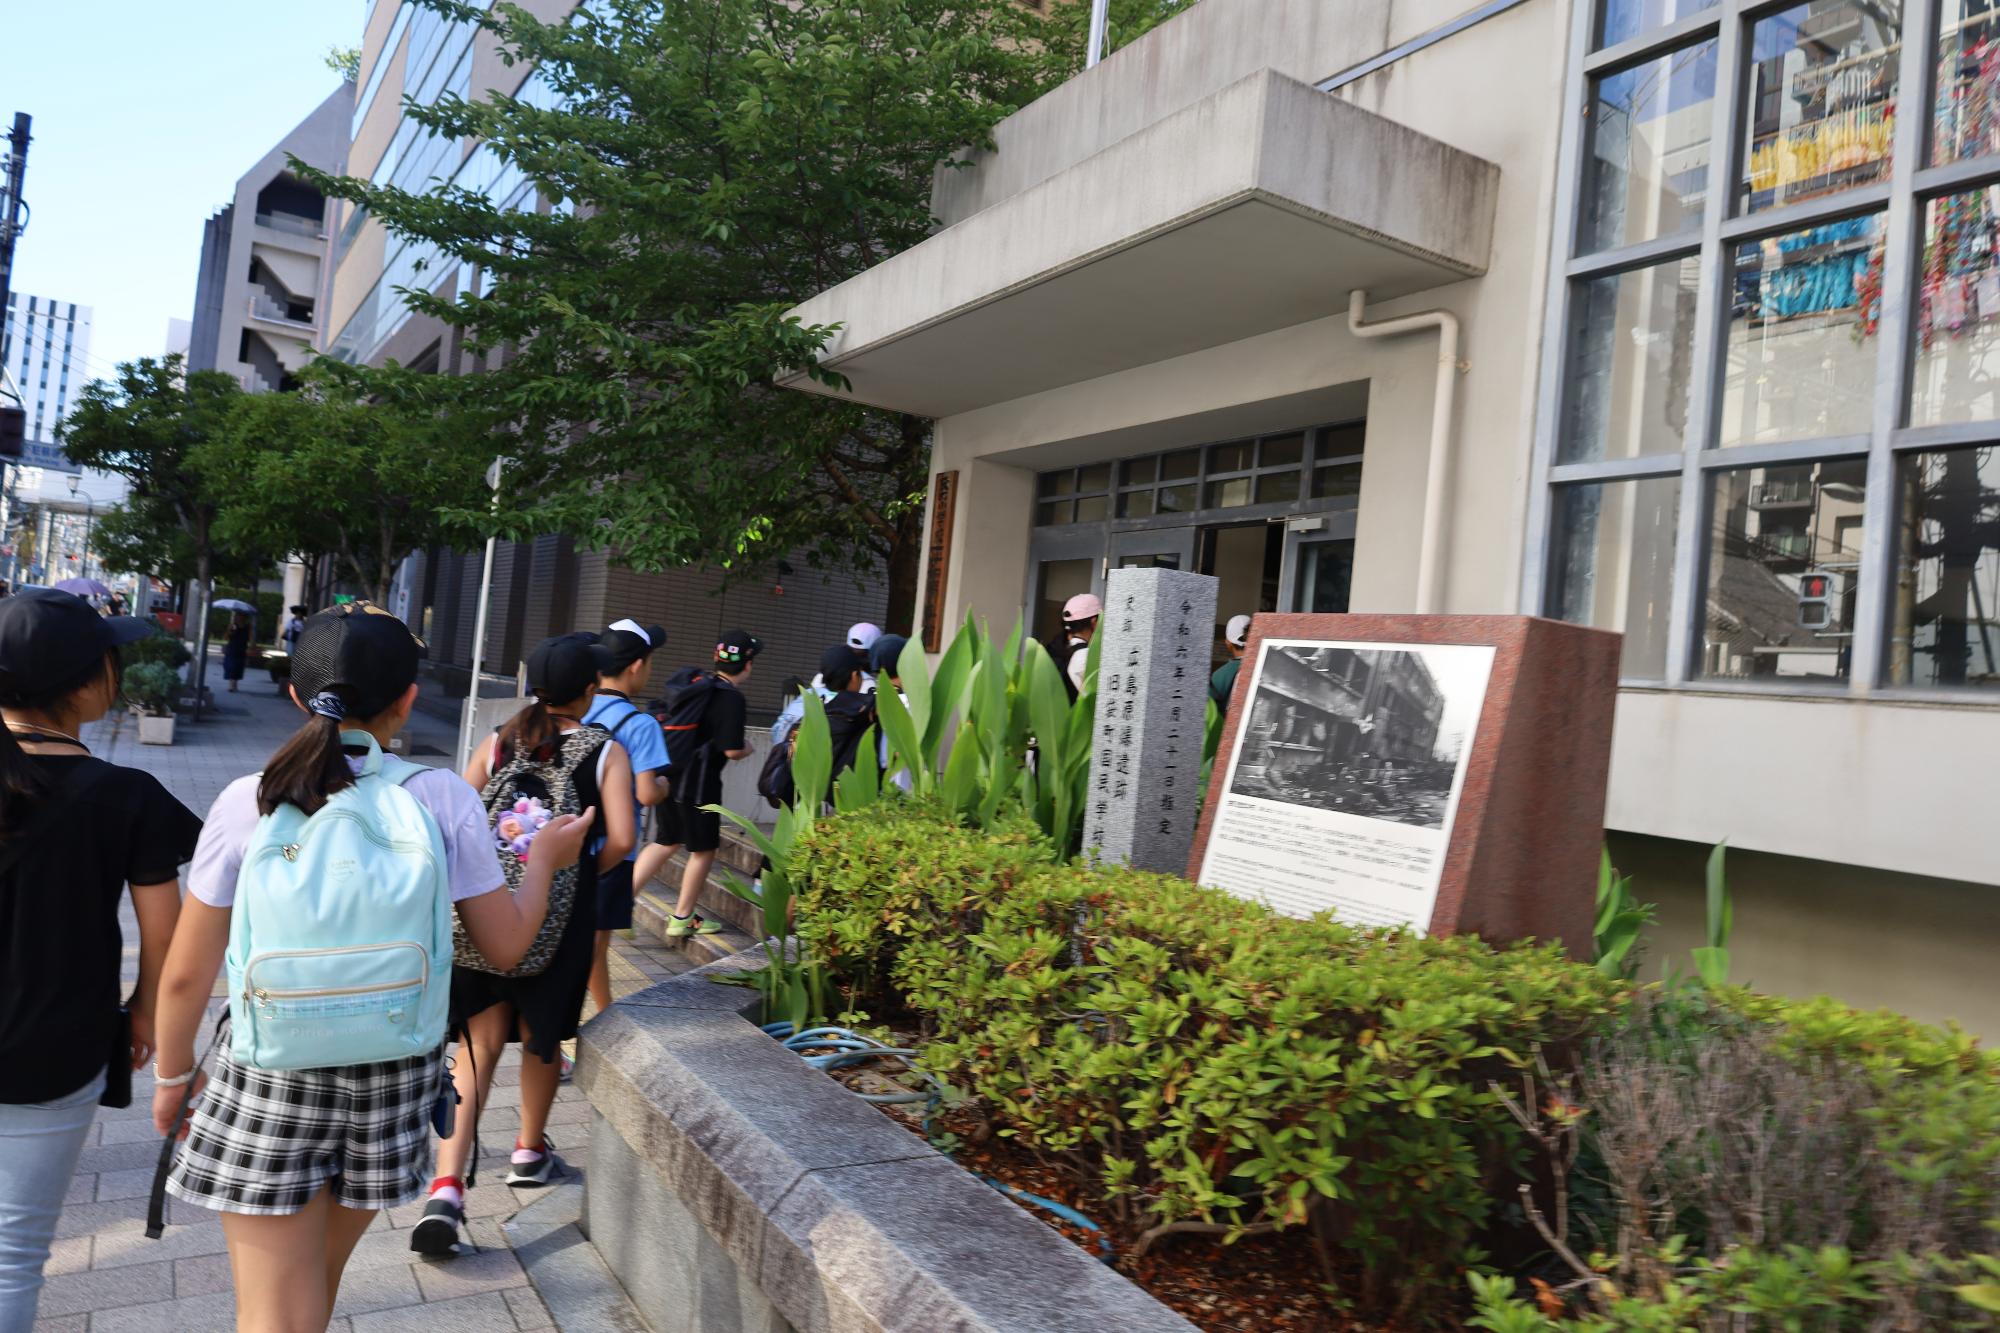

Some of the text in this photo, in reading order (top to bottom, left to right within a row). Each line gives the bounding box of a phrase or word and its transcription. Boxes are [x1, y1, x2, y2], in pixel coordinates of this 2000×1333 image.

[1159, 599, 1192, 835] 令和六年二月二十一日指定
